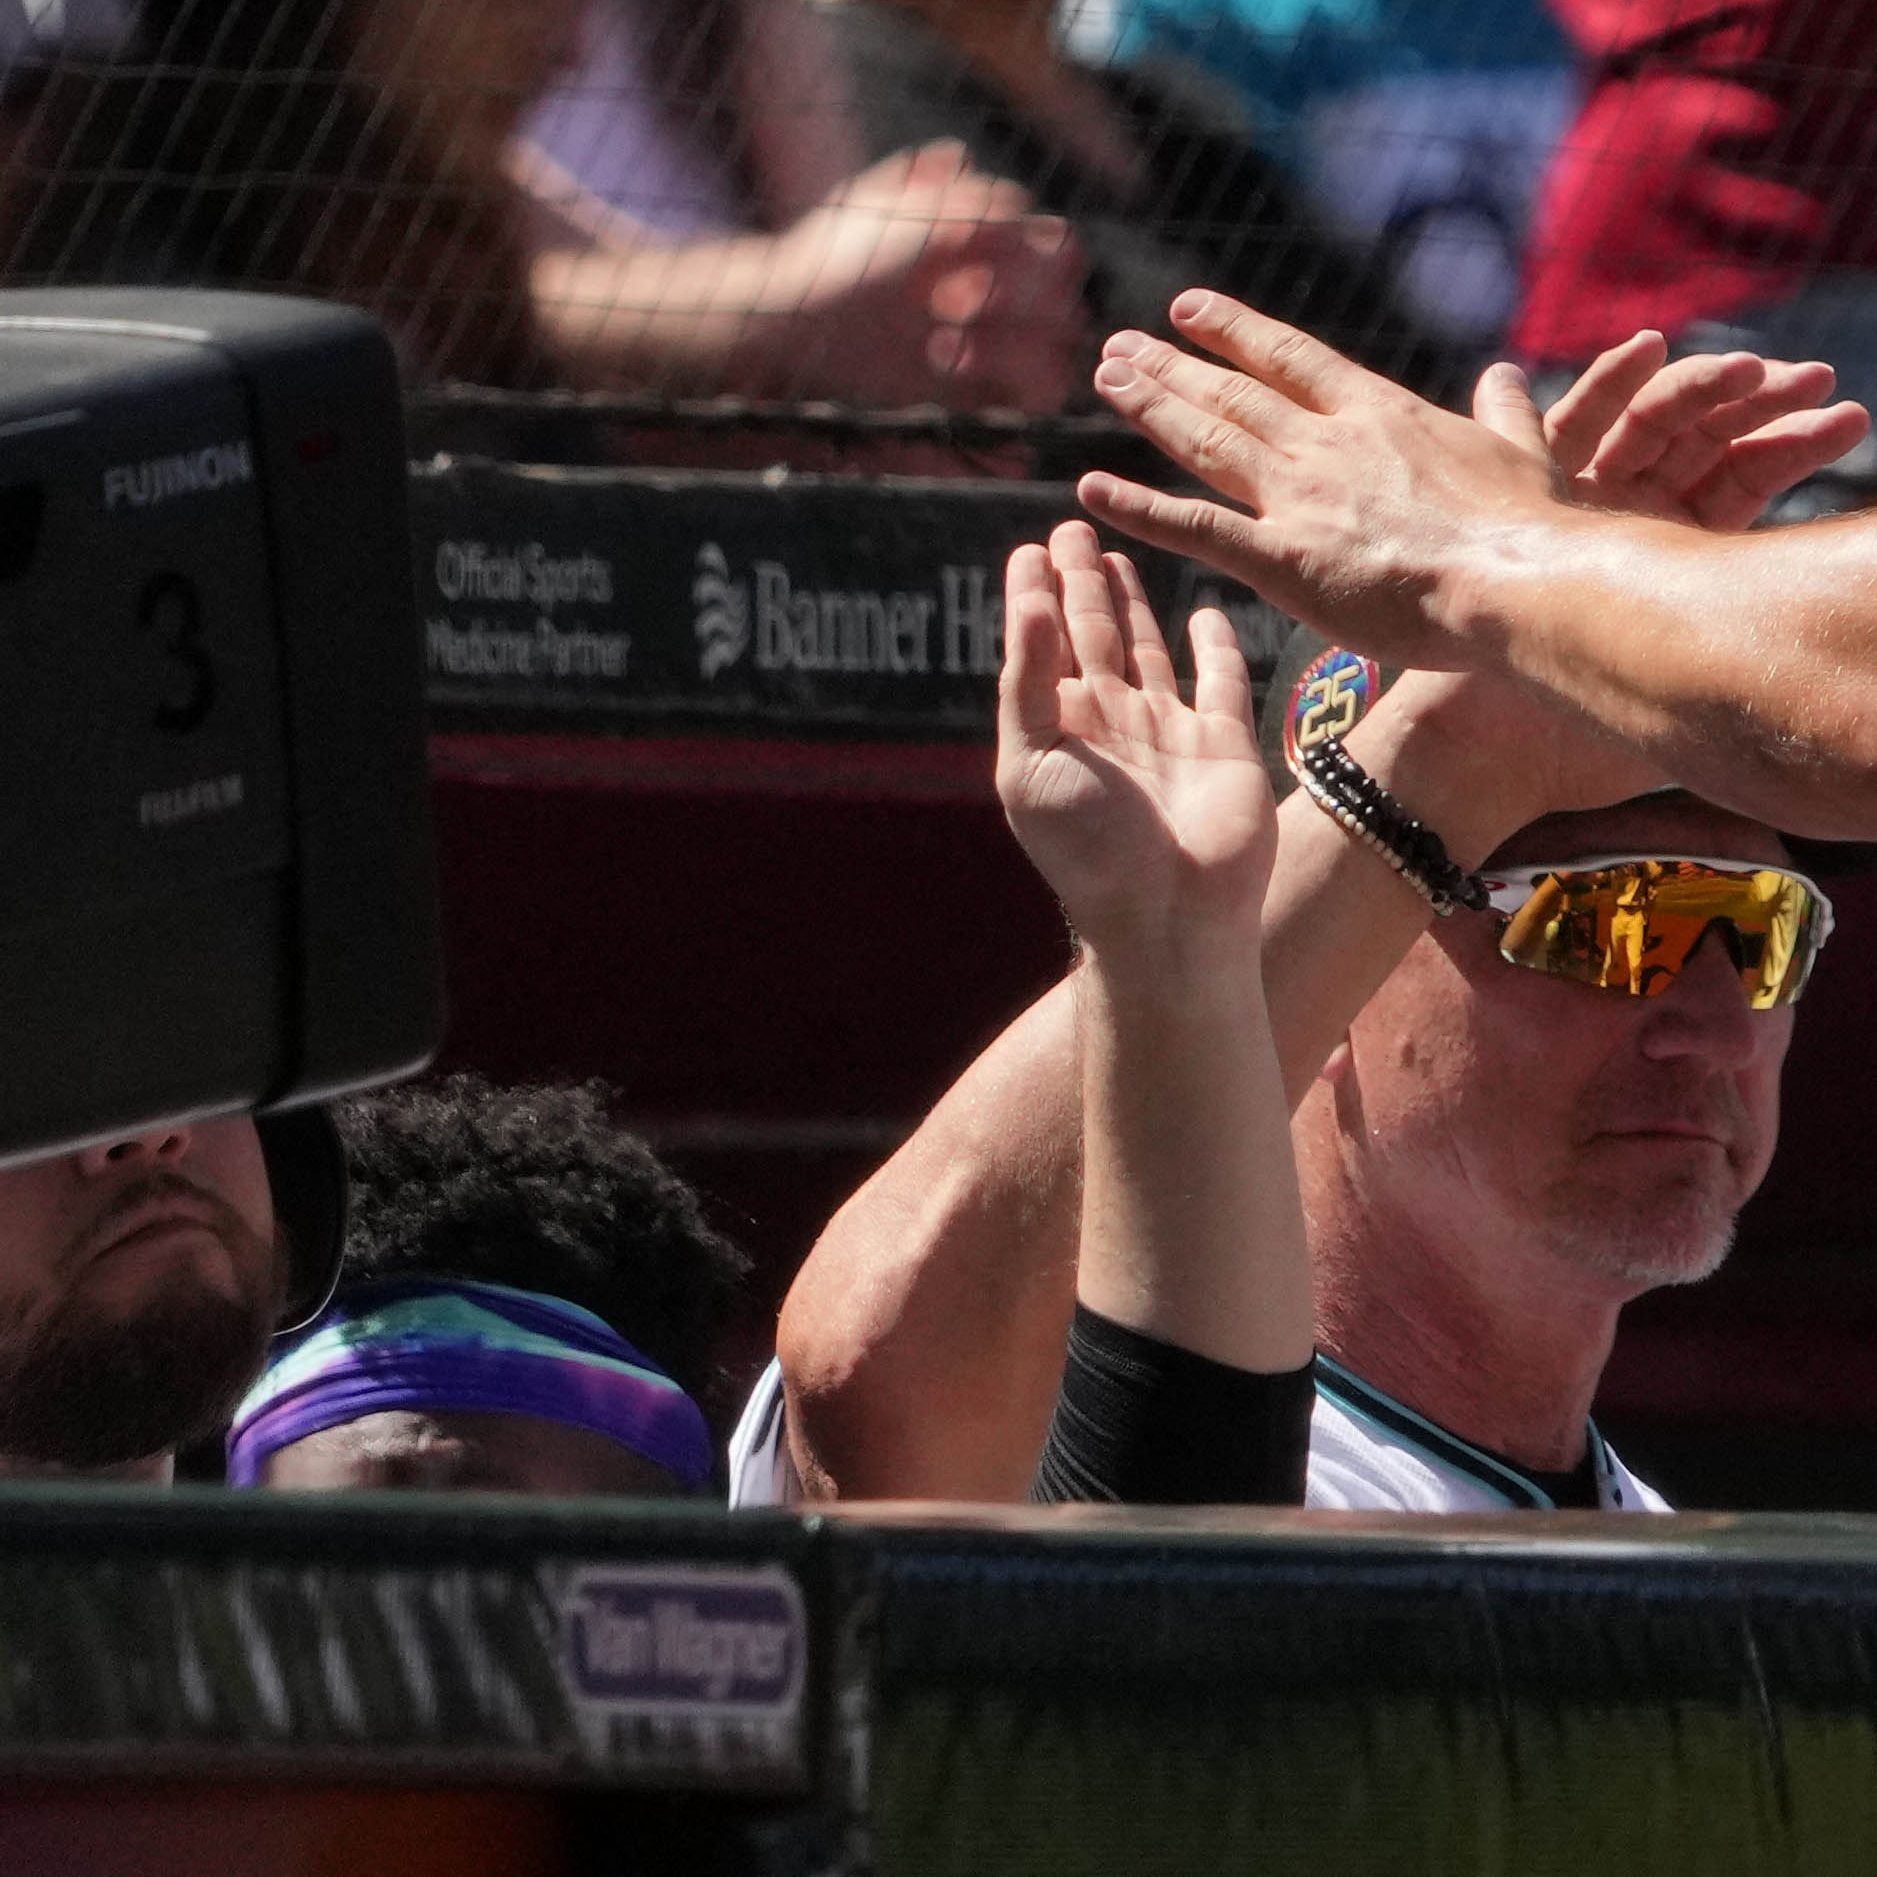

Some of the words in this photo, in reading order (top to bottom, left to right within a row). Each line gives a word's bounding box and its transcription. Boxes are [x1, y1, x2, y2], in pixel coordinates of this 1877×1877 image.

[138, 573, 213, 734] 3
[752, 559, 937, 675] Banner
[1300, 664, 1361, 749] 25
